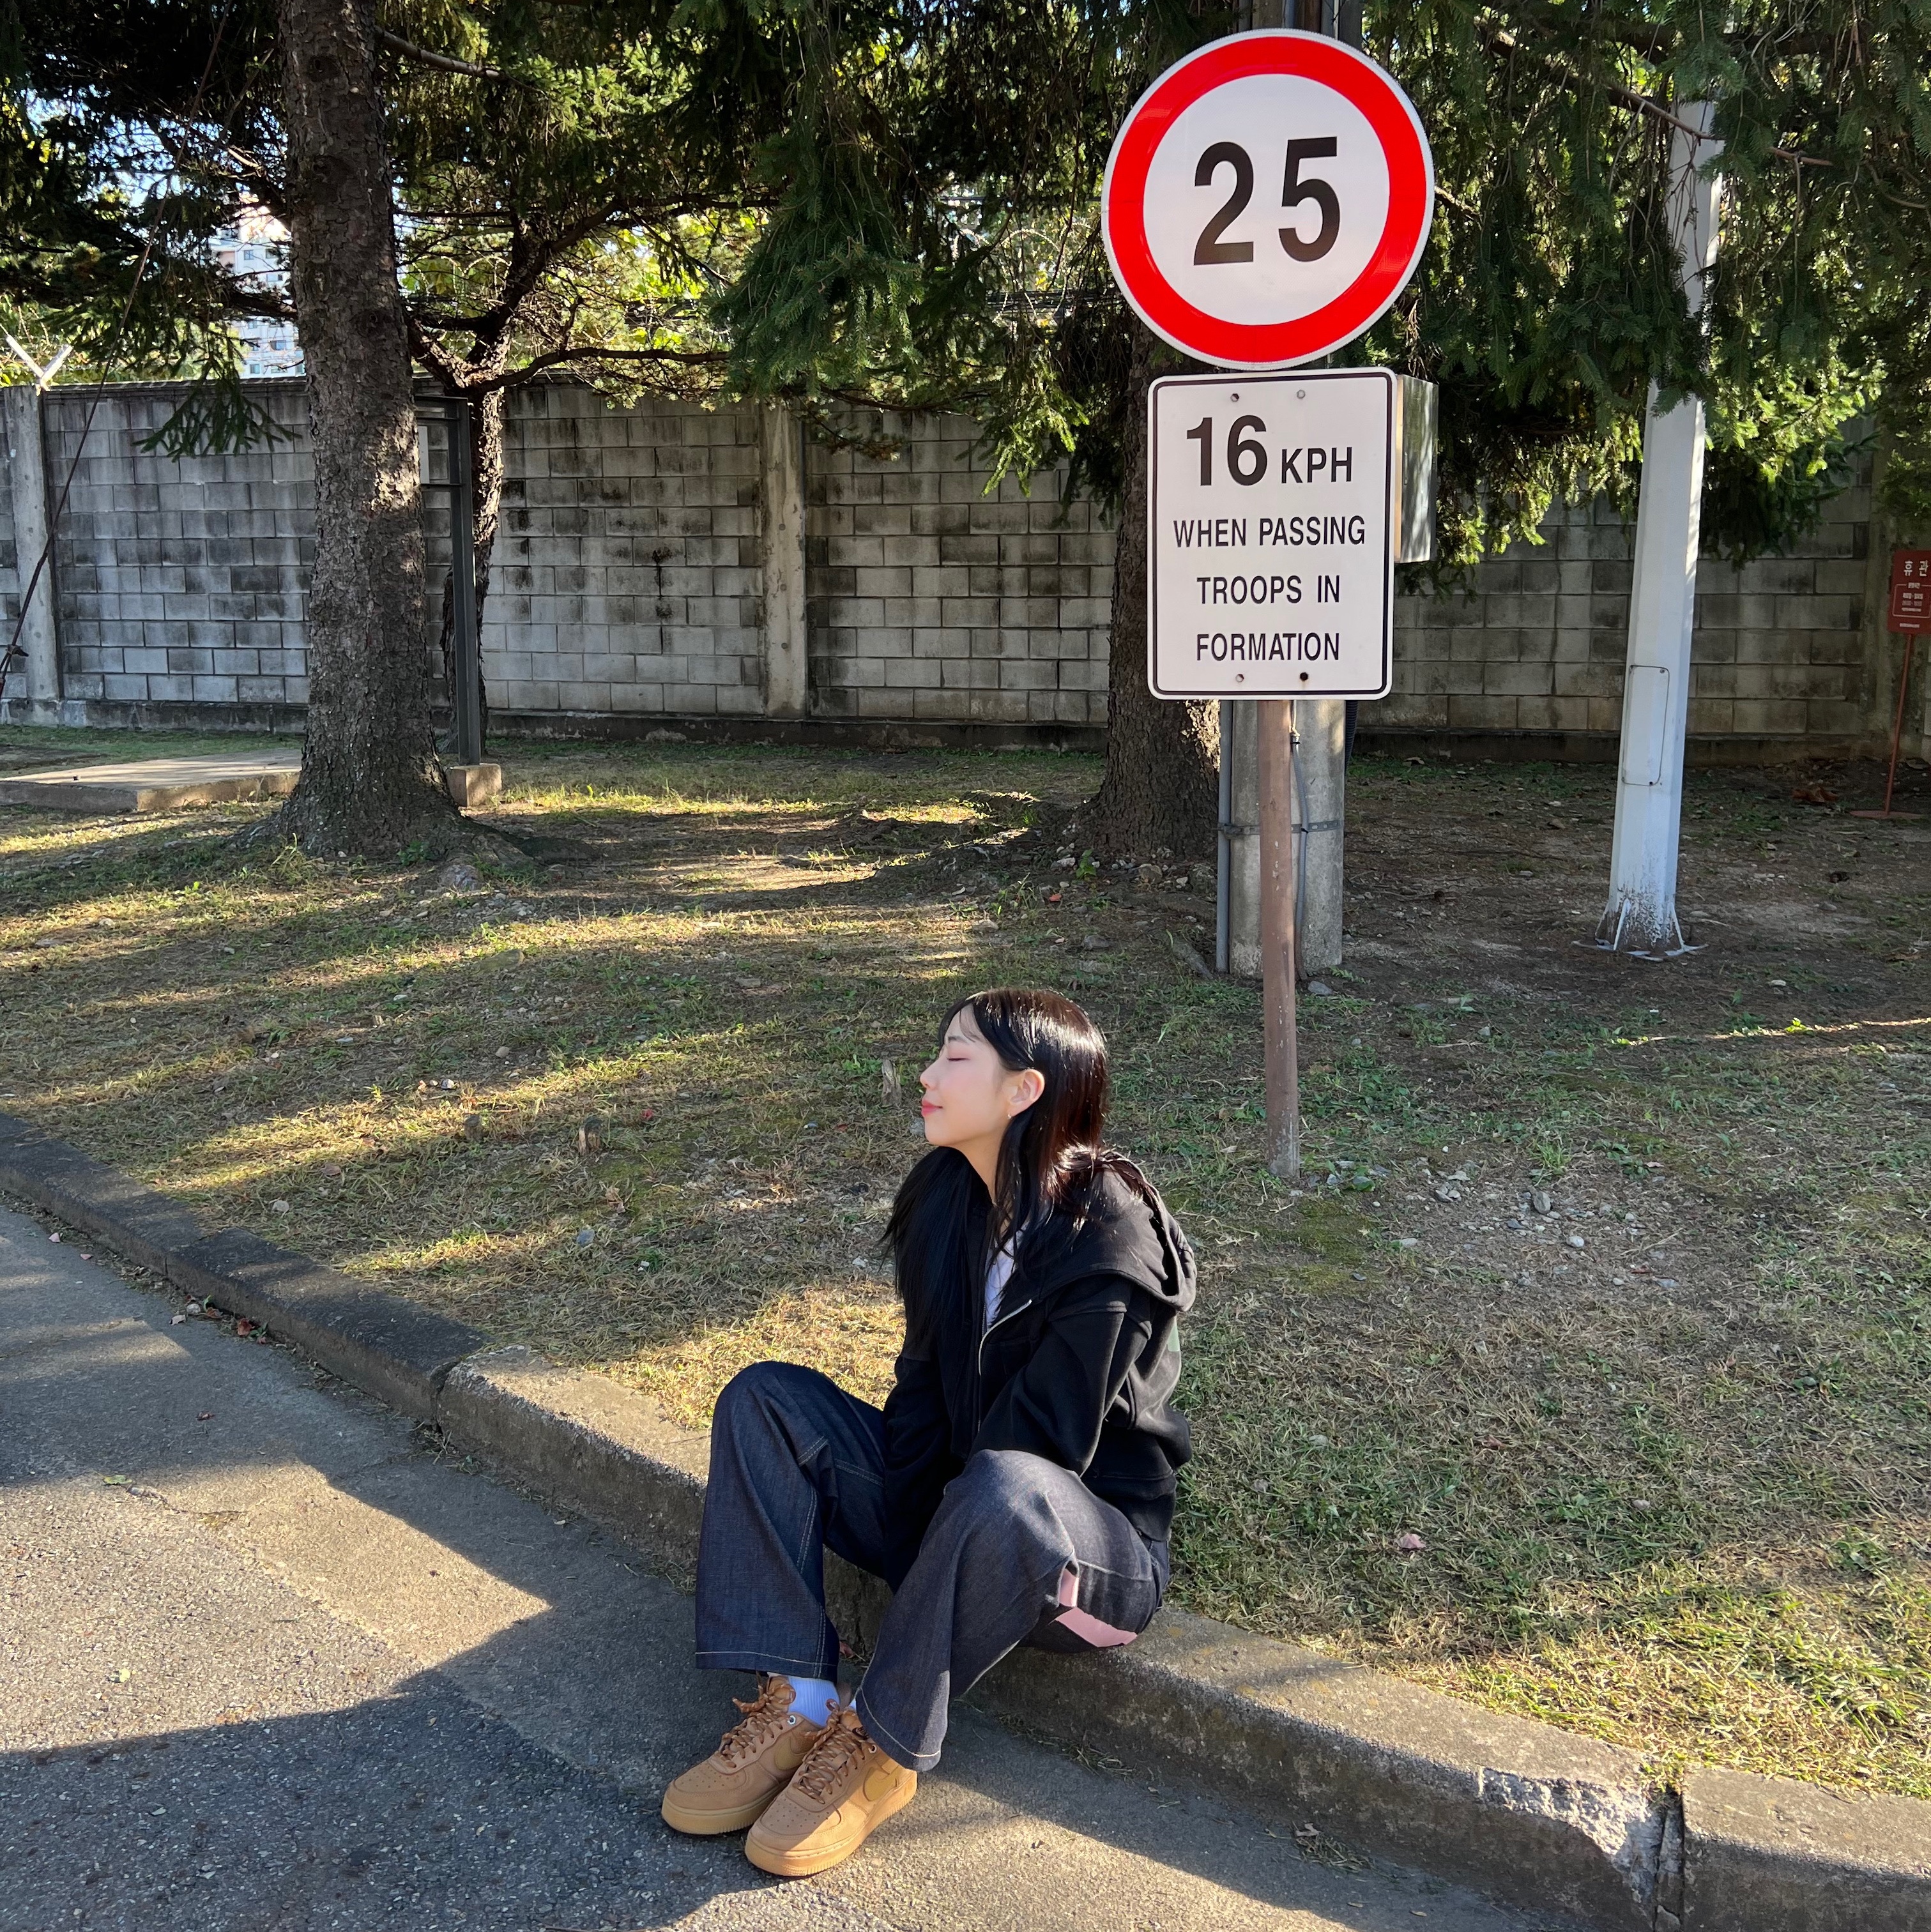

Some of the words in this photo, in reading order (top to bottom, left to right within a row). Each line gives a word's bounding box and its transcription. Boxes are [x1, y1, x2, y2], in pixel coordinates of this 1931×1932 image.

[1193, 136, 1340, 266] 25
[1186, 415, 1268, 486] 16
[1281, 446, 1352, 484] KPH
[1173, 518, 1246, 548] WHEN
[1259, 515, 1365, 546] PASSING
[1196, 575, 1302, 604] TROOPS
[1317, 575, 1339, 603] IN
[1196, 632, 1339, 662] FORMATION
